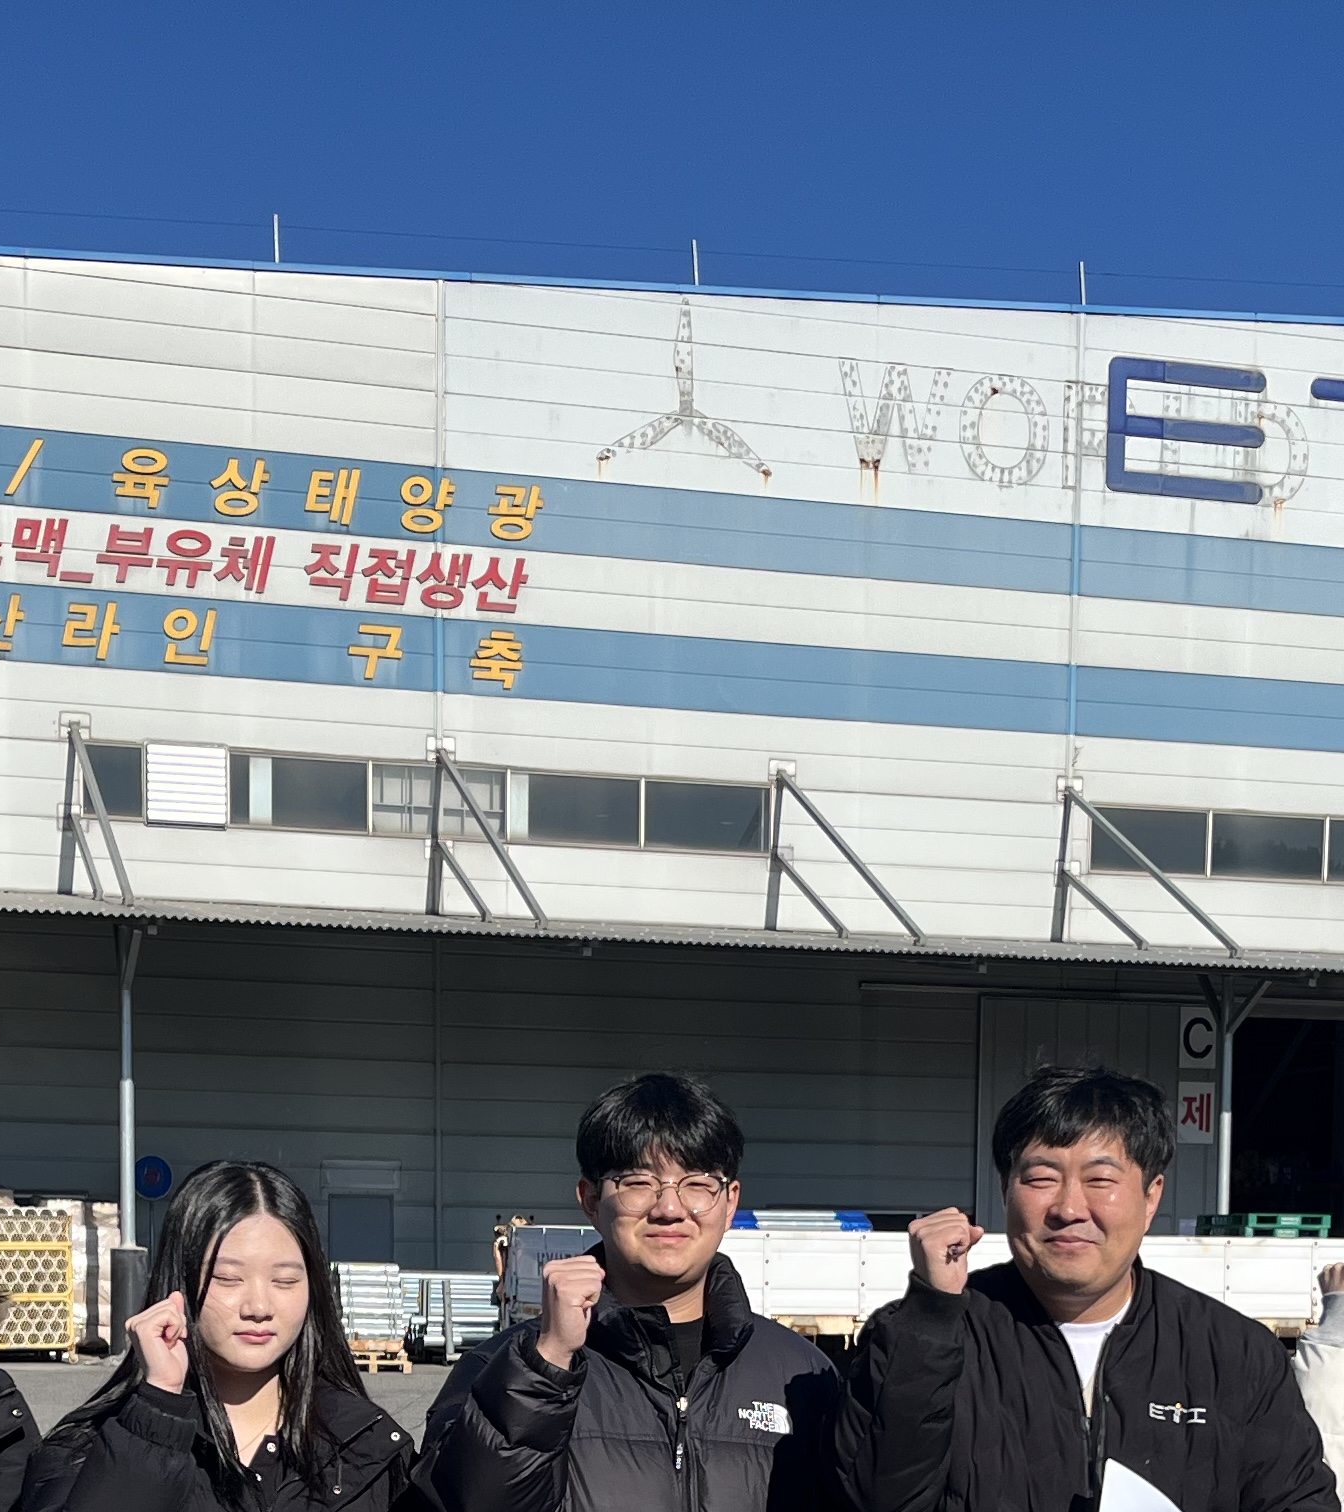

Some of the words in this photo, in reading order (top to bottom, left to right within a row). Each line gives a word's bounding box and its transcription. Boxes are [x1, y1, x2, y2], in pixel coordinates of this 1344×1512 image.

[5, 438, 44, 496] /
[304, 541, 529, 613] 직접생산
[348, 623, 525, 691] 구축
[1183, 1017, 1213, 1059] C
[738, 1408, 775, 1423] NORTH
[752, 1401, 774, 1412] THE
[1149, 1402, 1207, 1424] ETI
[749, 1420, 776, 1432] FACE
